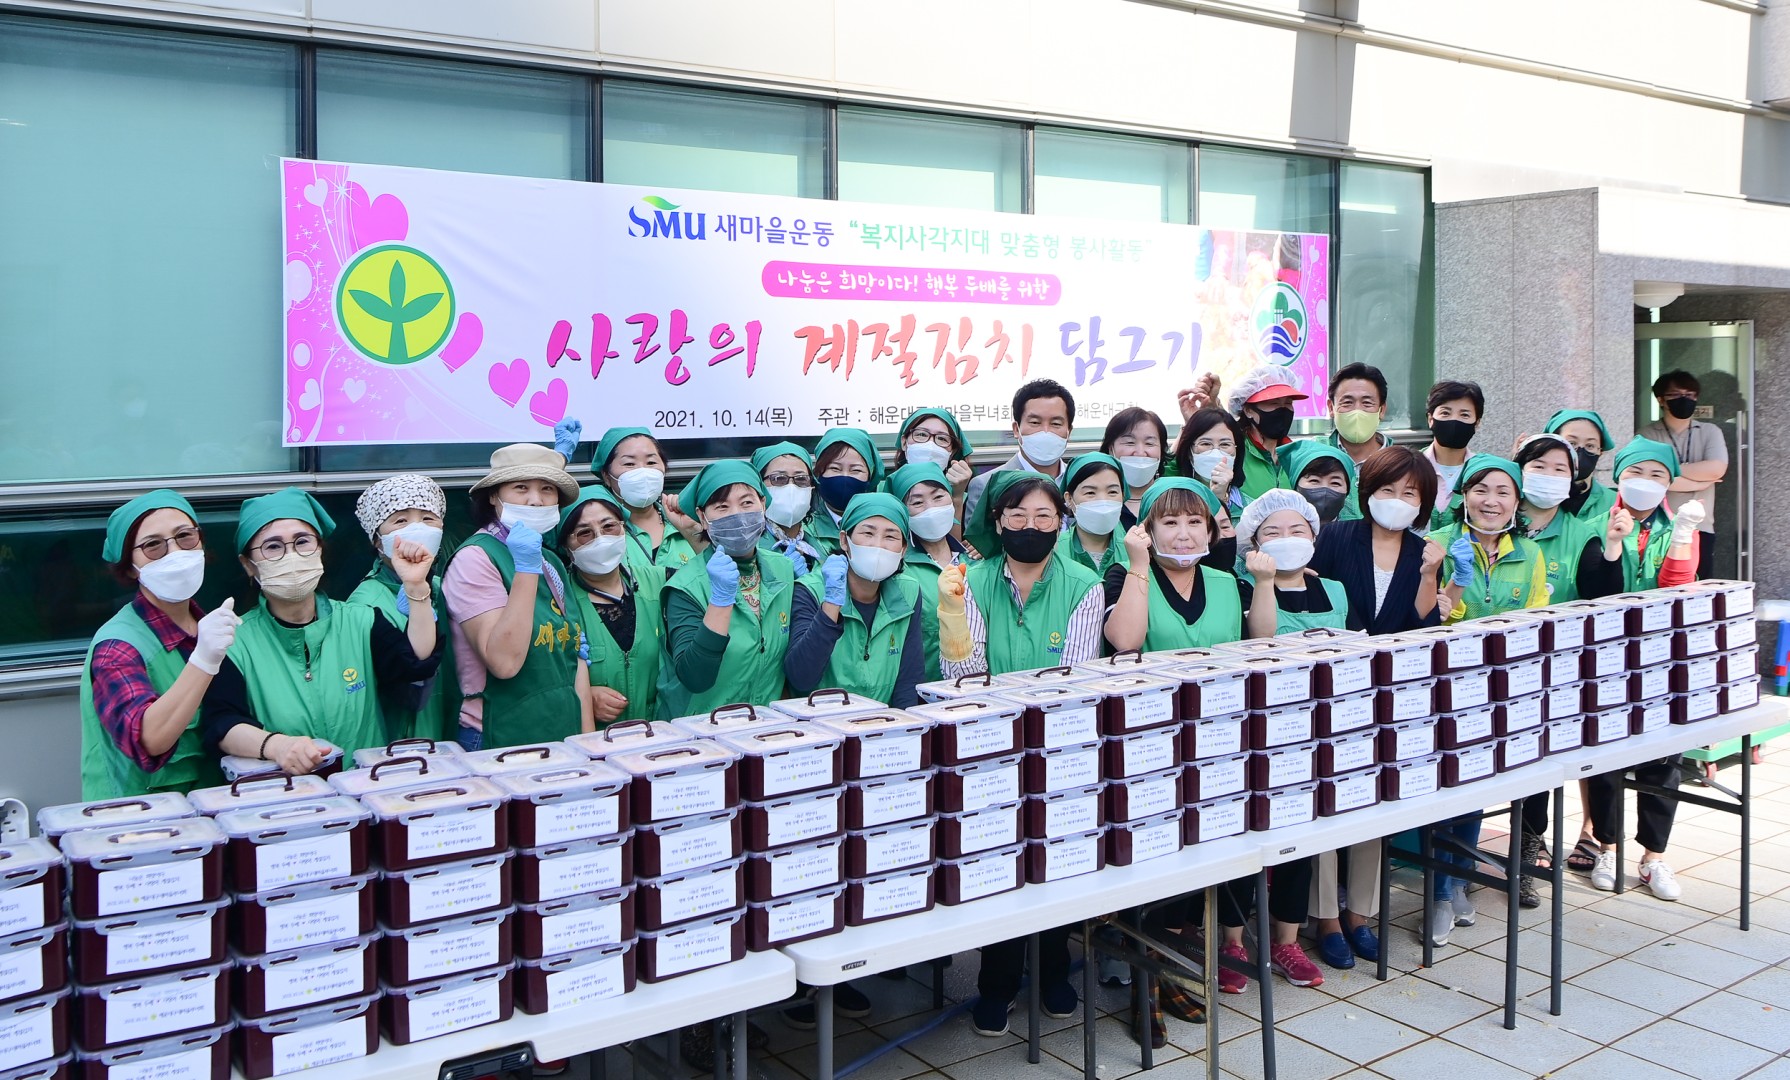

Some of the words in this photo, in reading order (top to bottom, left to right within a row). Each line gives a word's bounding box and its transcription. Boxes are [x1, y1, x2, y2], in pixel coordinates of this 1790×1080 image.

[628, 205, 707, 241] SMU
[714, 213, 835, 248] 새마을운동
[1000, 231, 1060, 260] 맞춤형
[778, 269, 832, 294] 나눔은
[839, 271, 919, 295] 희망이다!
[924, 273, 960, 298] 행복
[964, 275, 1012, 301] 두배를
[1017, 274, 1051, 301] 위한
[546, 309, 762, 386] 사랑의
[793, 313, 1034, 388] 계절김치
[1058, 315, 1203, 387] 담그기
[654, 409, 703, 429] 2021.
[712, 409, 737, 428] 10.
[746, 406, 793, 428] 14(목)
[817, 406, 849, 426] 주관
[869, 403, 1014, 425] 해운대마을부녀회
[1077, 401, 1138, 419] 해운대구
